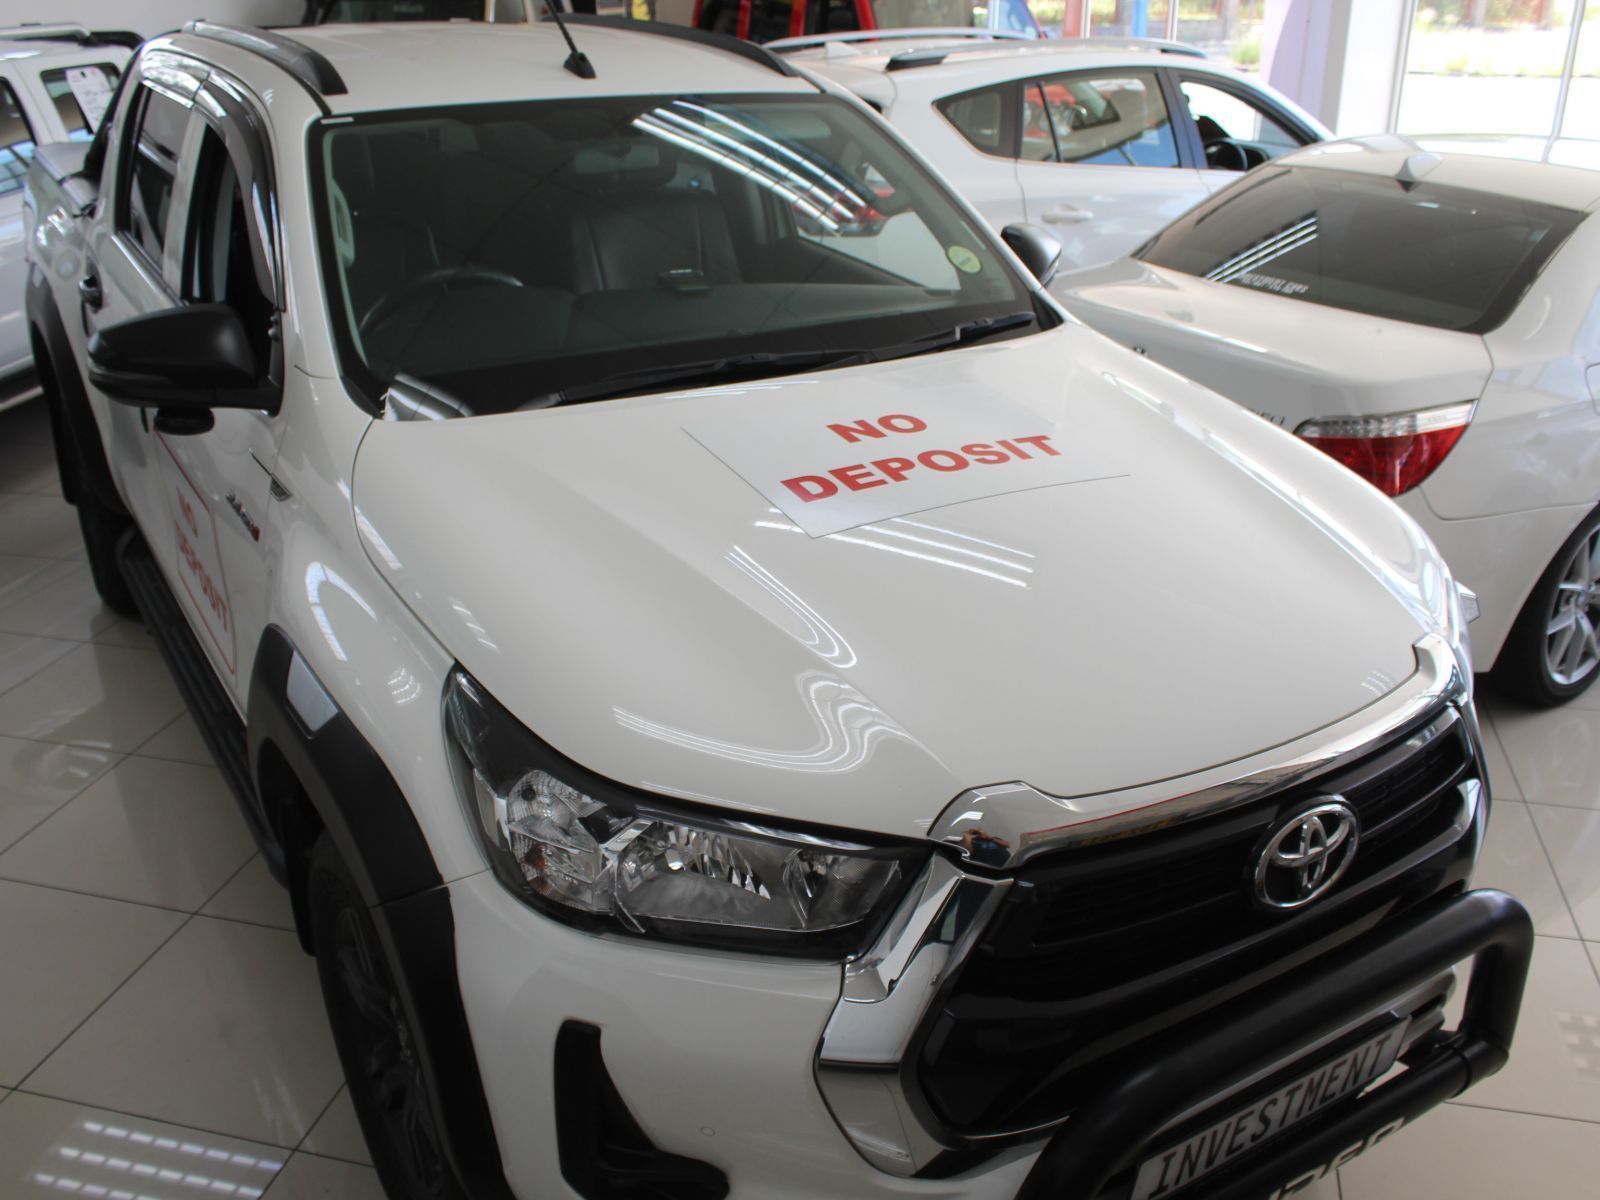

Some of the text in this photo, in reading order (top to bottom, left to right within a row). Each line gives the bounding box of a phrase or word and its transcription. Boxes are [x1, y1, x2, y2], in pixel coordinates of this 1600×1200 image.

[826, 413, 928, 444] NO
[779, 434, 1063, 504] DEPOSIT
[1149, 1034, 1391, 1196] INVESTMENT
